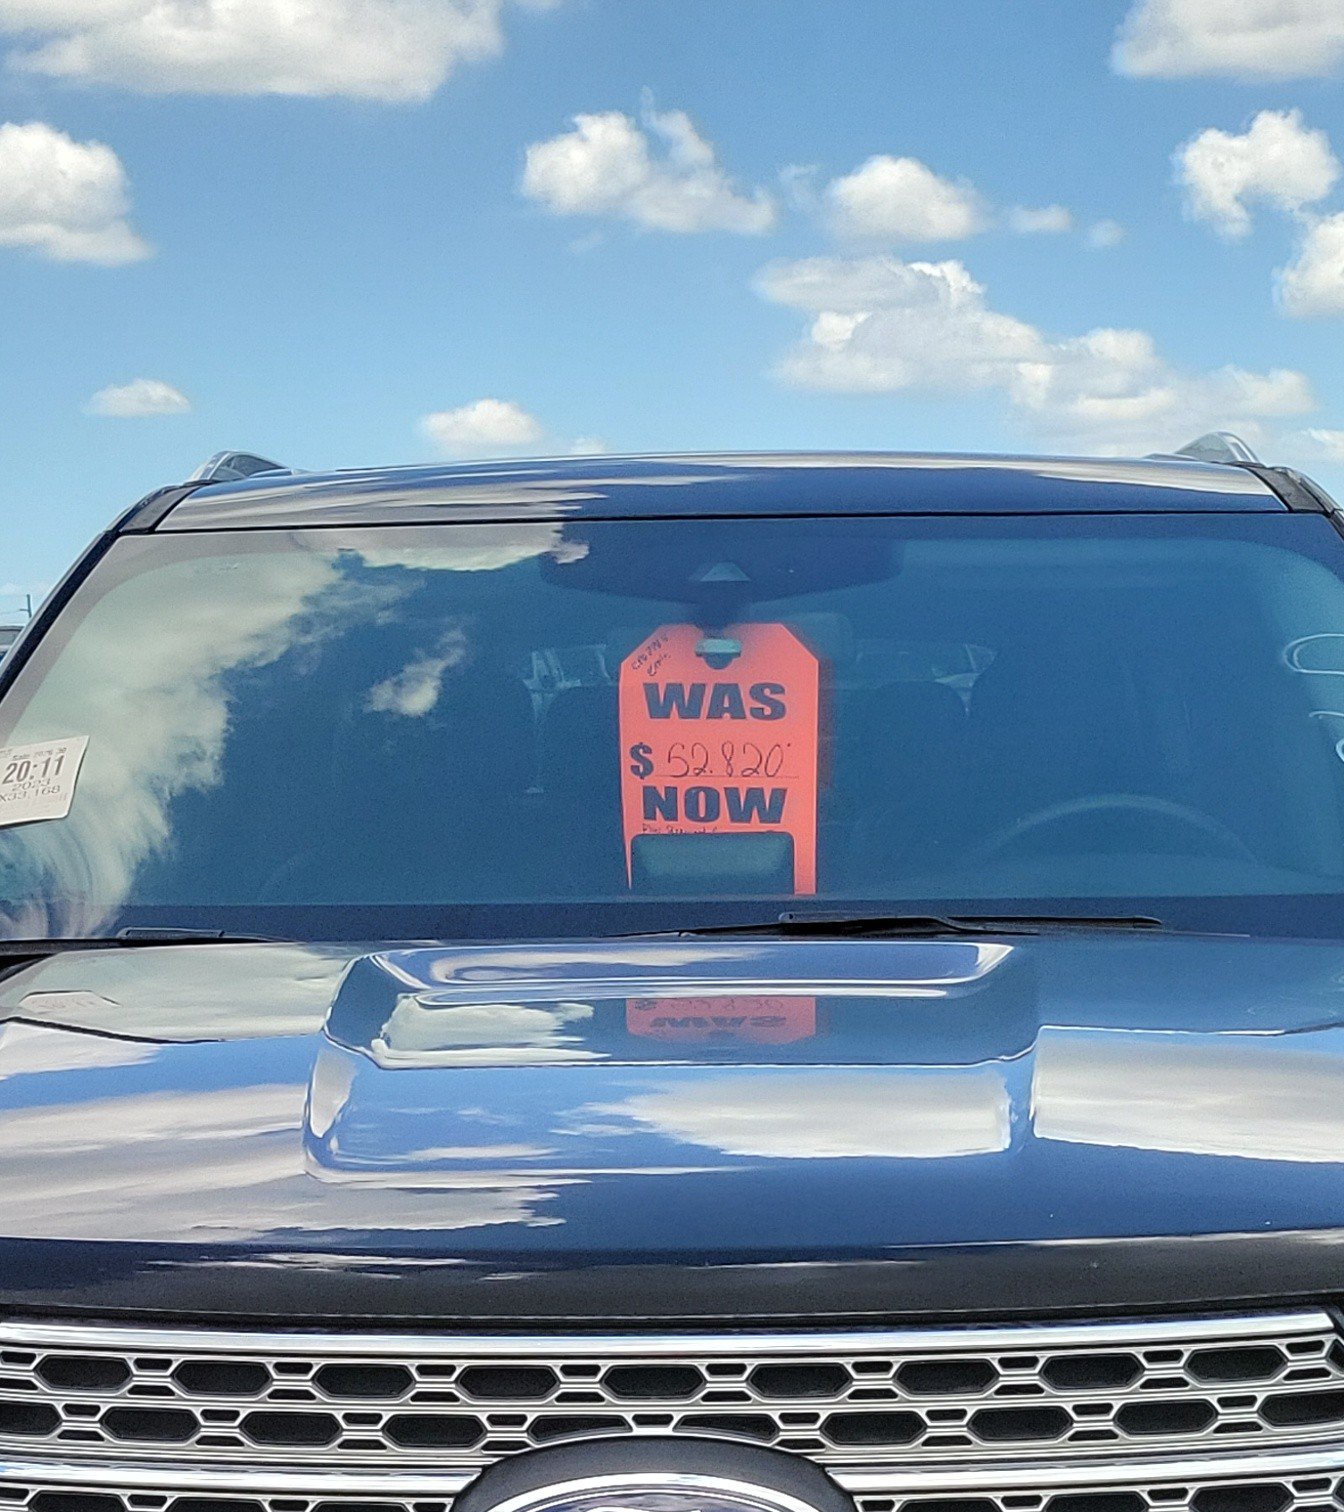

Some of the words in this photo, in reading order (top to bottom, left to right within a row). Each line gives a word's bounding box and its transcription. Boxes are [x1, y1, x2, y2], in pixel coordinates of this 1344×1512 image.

[643, 682, 787, 721] WAS
[2, 755, 65, 784] 20:11
[629, 742, 654, 780] $
[642, 786, 788, 824] NOW
